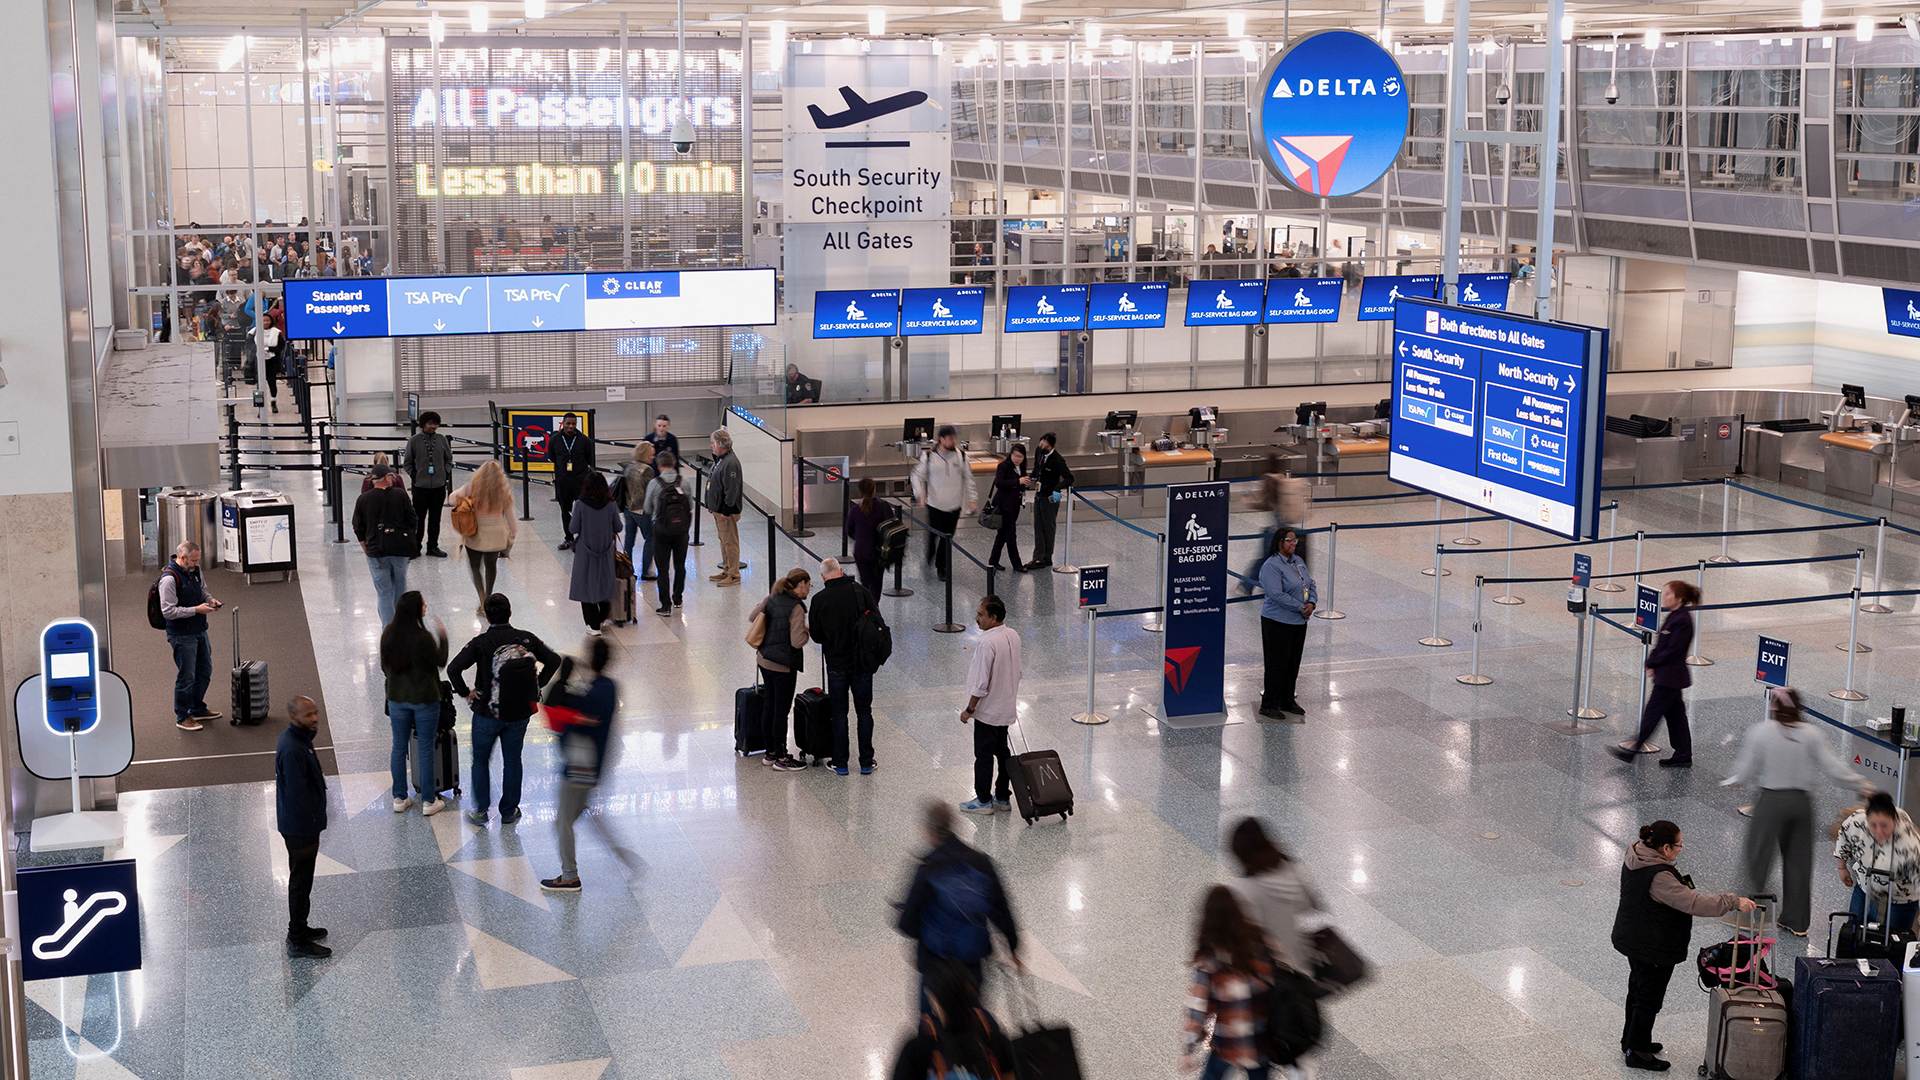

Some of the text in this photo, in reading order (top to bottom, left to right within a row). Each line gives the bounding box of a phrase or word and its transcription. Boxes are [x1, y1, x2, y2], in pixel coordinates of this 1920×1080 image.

[1300, 79, 1376, 96] DELTA
[411, 88, 736, 135] All Passengers
[416, 161, 736, 196] Less than 10 min
[793, 167, 941, 190] South Security
[812, 195, 923, 218] Checkpoint
[822, 231, 913, 250] All Gates
[624, 280, 662, 290] CLEAR
[312, 290, 362, 302] Standard
[404, 292, 430, 305] TSA
[504, 288, 529, 302] TSA
[306, 303, 370, 316] Passengers
[906, 320, 945, 328] SELF-SERVICE
[1011, 317, 1049, 325] SELF-SERVICE
[1093, 314, 1130, 322] SELF-SERVICE
[820, 322, 860, 330] SELF-SERVICE
[1440, 318, 1545, 349] Both directions to All Gates
[1412, 344, 1465, 370] South Security
[1498, 362, 1559, 391] North Security
[1522, 395, 1531, 406] All
[1516, 408, 1563, 428] Less than 15 min
[1488, 448, 1517, 465] First Class
[1440, 474, 1479, 498] Restrooms
[1185, 490, 1215, 499] DELTA
[1500, 492, 1537, 516] Elevators
[1173, 545, 1222, 555] SELF-SERVICE
[1178, 554, 1217, 563] BAG DROP
[1083, 579, 1105, 590] EXIT
[1640, 599, 1657, 613] EXIT
[1762, 651, 1786, 667] EXIT
[1864, 758, 1899, 779] DELTA
